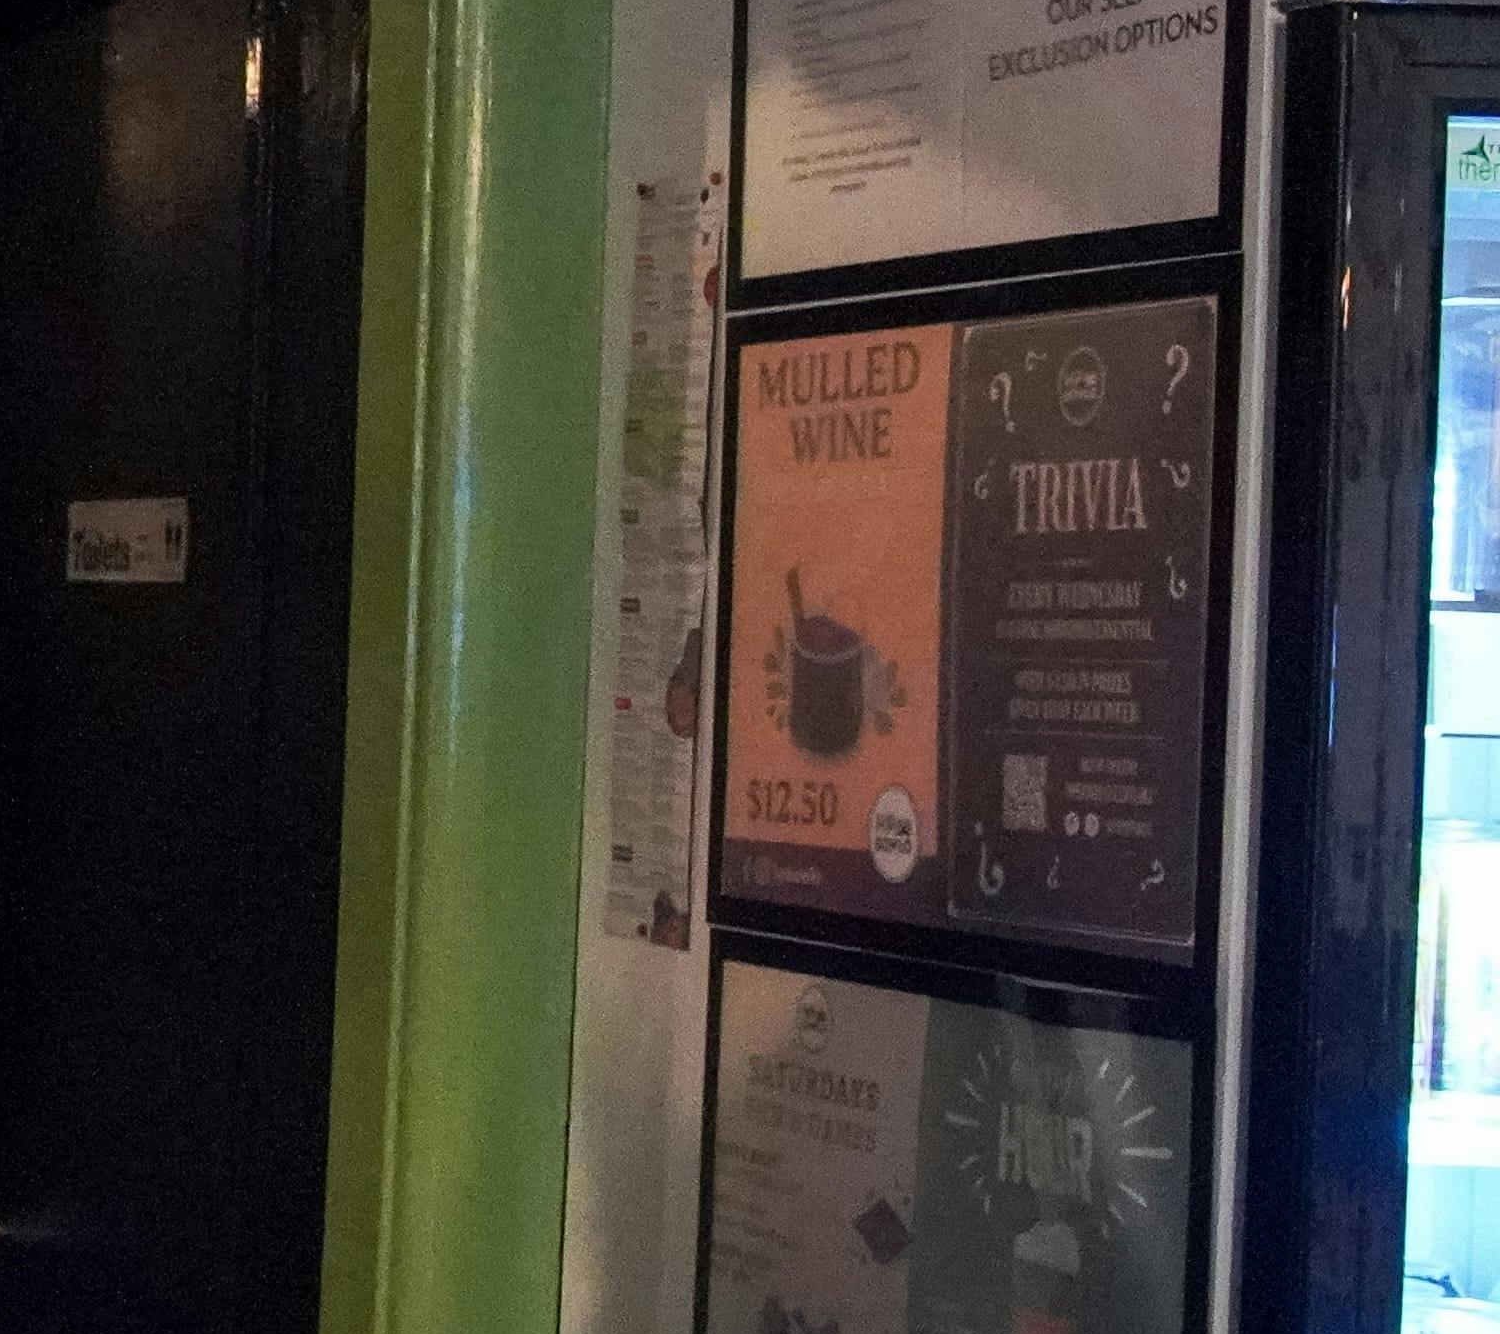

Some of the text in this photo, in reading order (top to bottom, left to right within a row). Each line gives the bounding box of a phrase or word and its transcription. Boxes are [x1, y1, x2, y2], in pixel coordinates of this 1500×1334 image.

[1114, 4, 1219, 54] OPTIONS
[757, 339, 921, 413] MULLED
[789, 410, 895, 465] WINE
[1009, 457, 1149, 535] TRIVIA
[746, 778, 838, 828] $12.50
